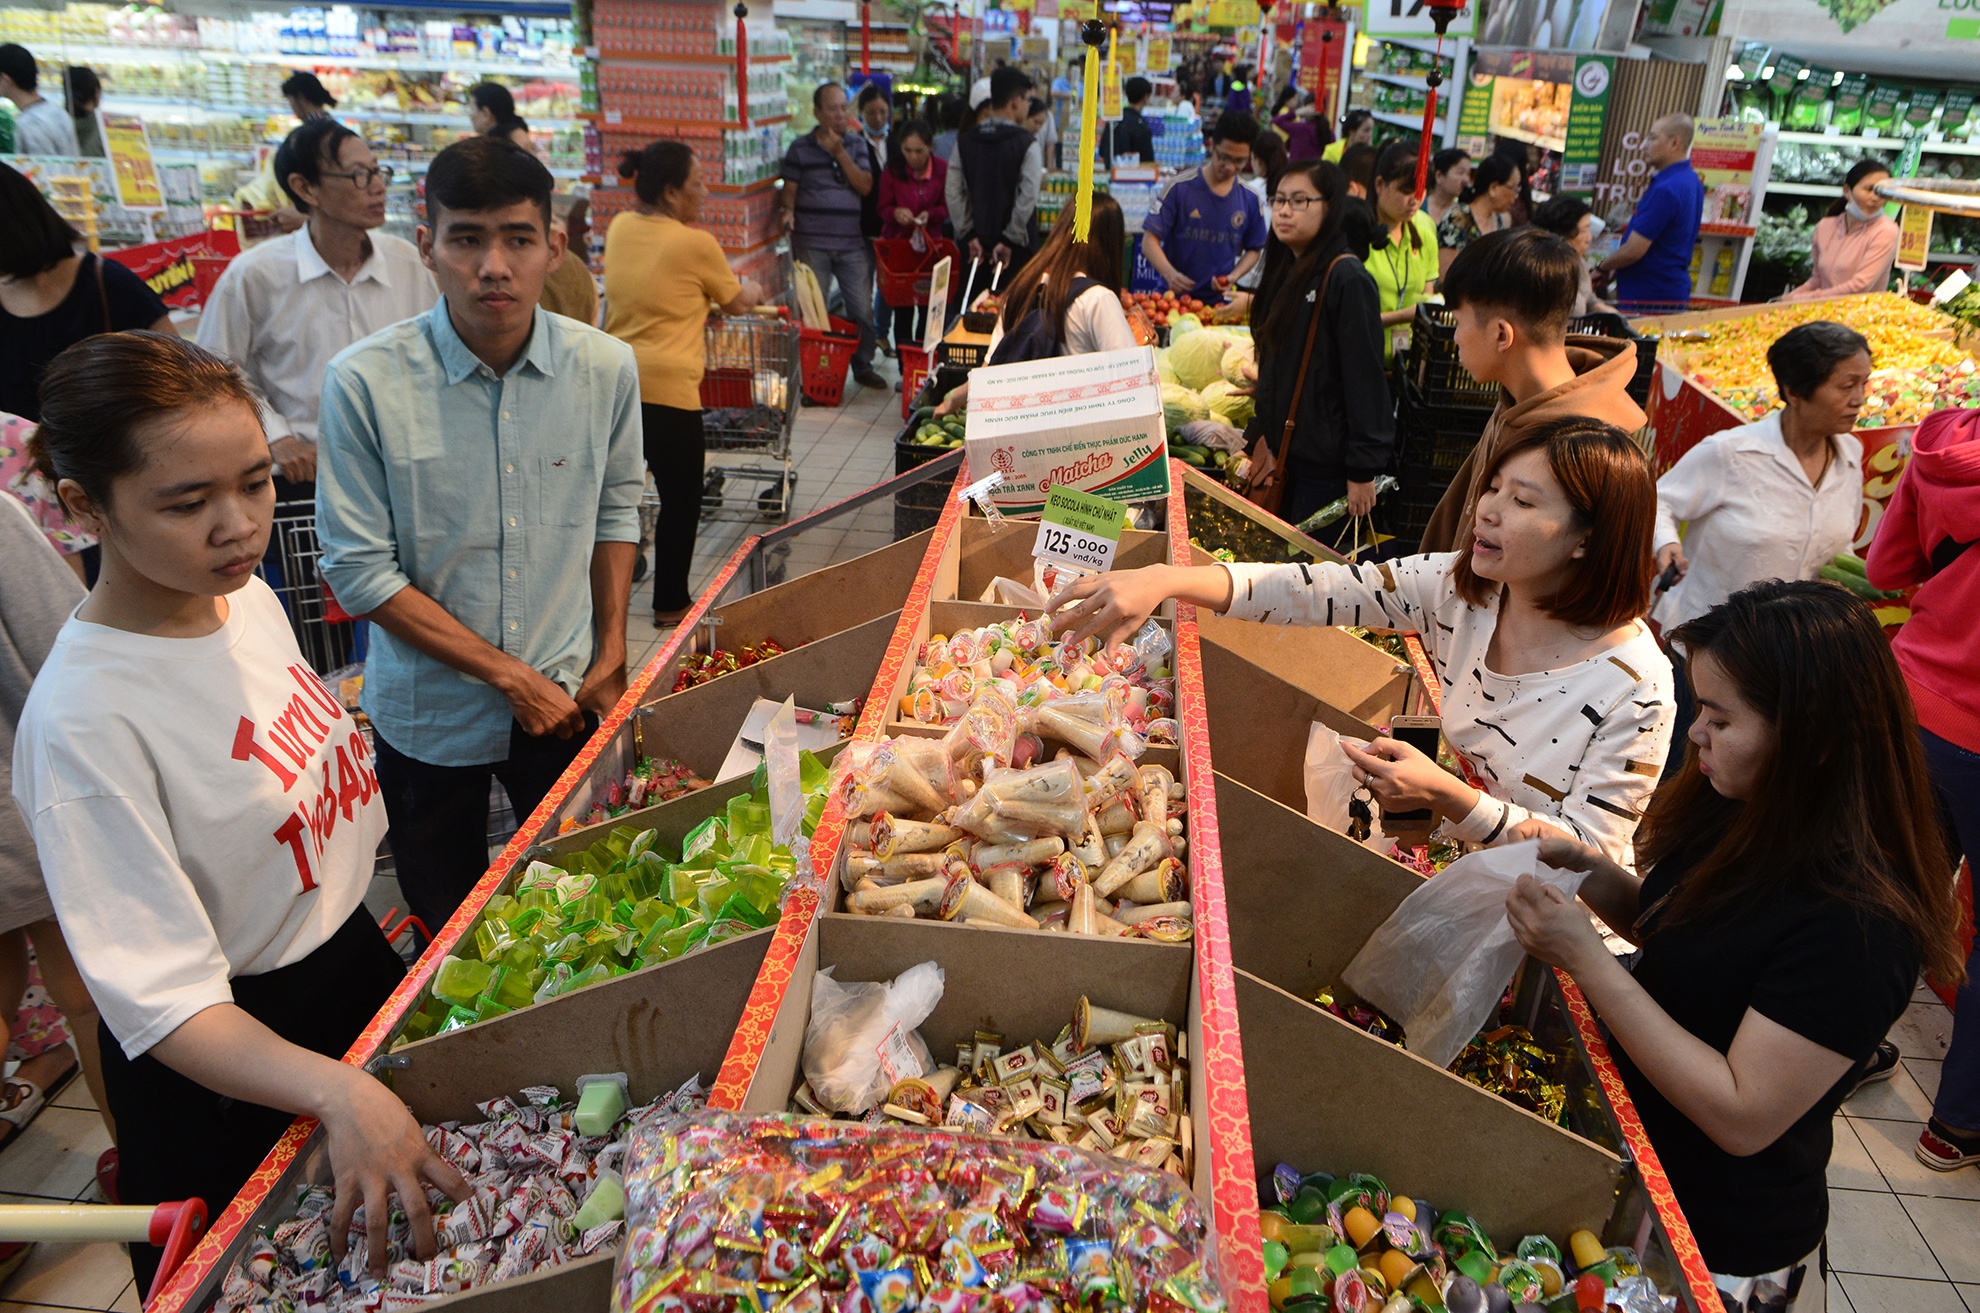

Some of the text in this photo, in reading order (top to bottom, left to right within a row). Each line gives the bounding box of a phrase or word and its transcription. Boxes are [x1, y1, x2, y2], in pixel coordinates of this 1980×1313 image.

[1137, 268, 1159, 280] MIL
[1088, 402, 1106, 410] TNHH
[1117, 396, 1136, 404] CÔNG
[1022, 433, 1148, 458] CÔNG TY TNHH CHẾ BIẾN THỰC PHẨM ĐỨC HẠNH
[1039, 444, 1153, 492] Matcha Jelly
[1002, 484, 1015, 494] TRÀ
[1016, 483, 1036, 492] XANH
[1050, 494, 1118, 524] KẸO SOCOLA HÌNH CHỮ NHẬT
[1073, 553, 1104, 567] vnđ/kg
[230, 662, 346, 794] Turn U
